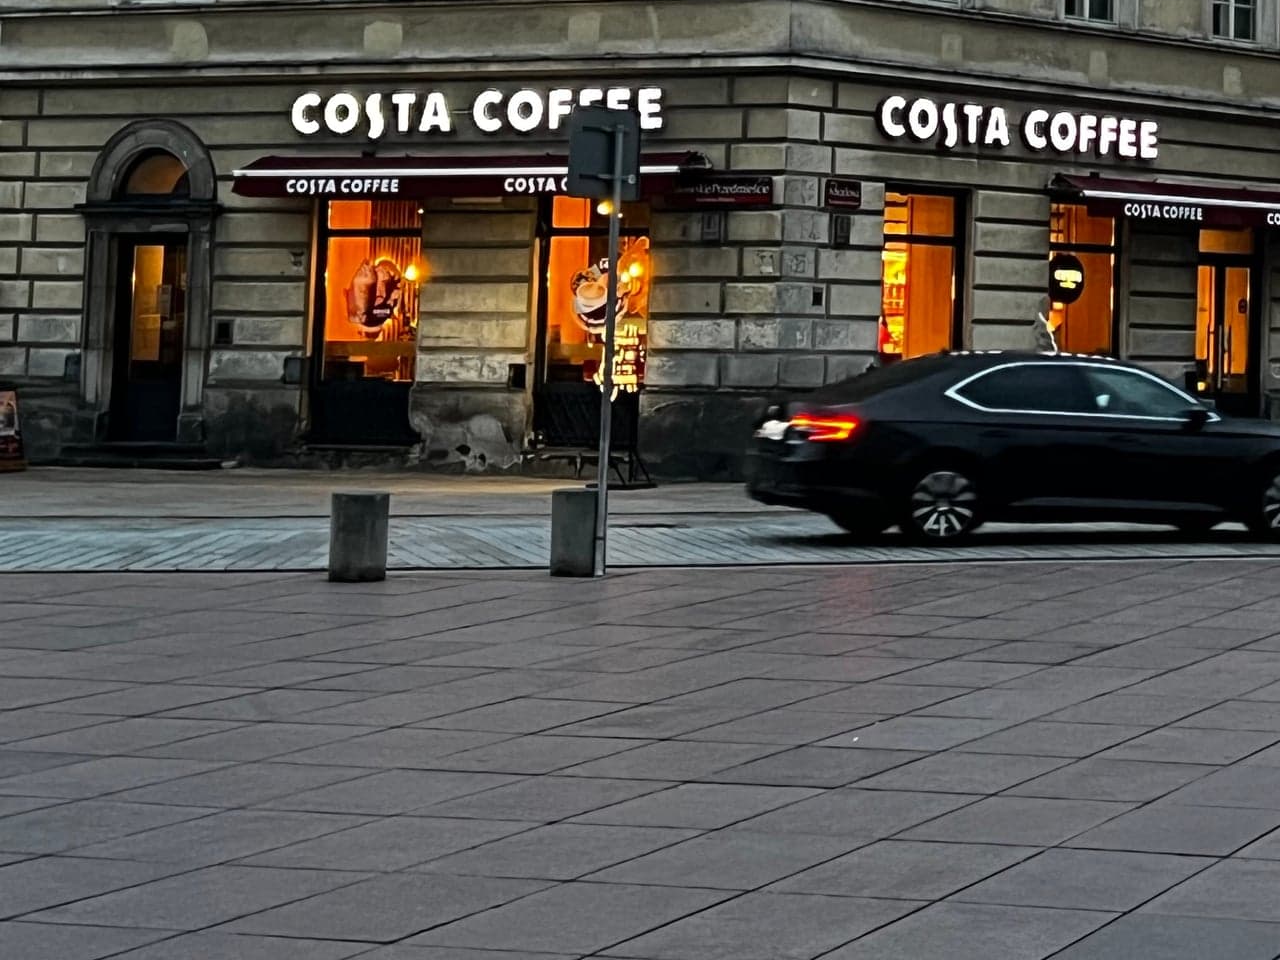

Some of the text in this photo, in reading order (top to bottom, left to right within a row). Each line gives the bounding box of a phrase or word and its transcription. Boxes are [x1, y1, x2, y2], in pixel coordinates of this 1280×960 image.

[291, 92, 451, 139] COSTA
[881, 95, 1158, 159] COSTA COFFEE
[286, 178, 399, 194] COSTA COFFEE
[503, 177, 556, 194] COSTA
[1124, 203, 1203, 221] COSTA COFFEE
